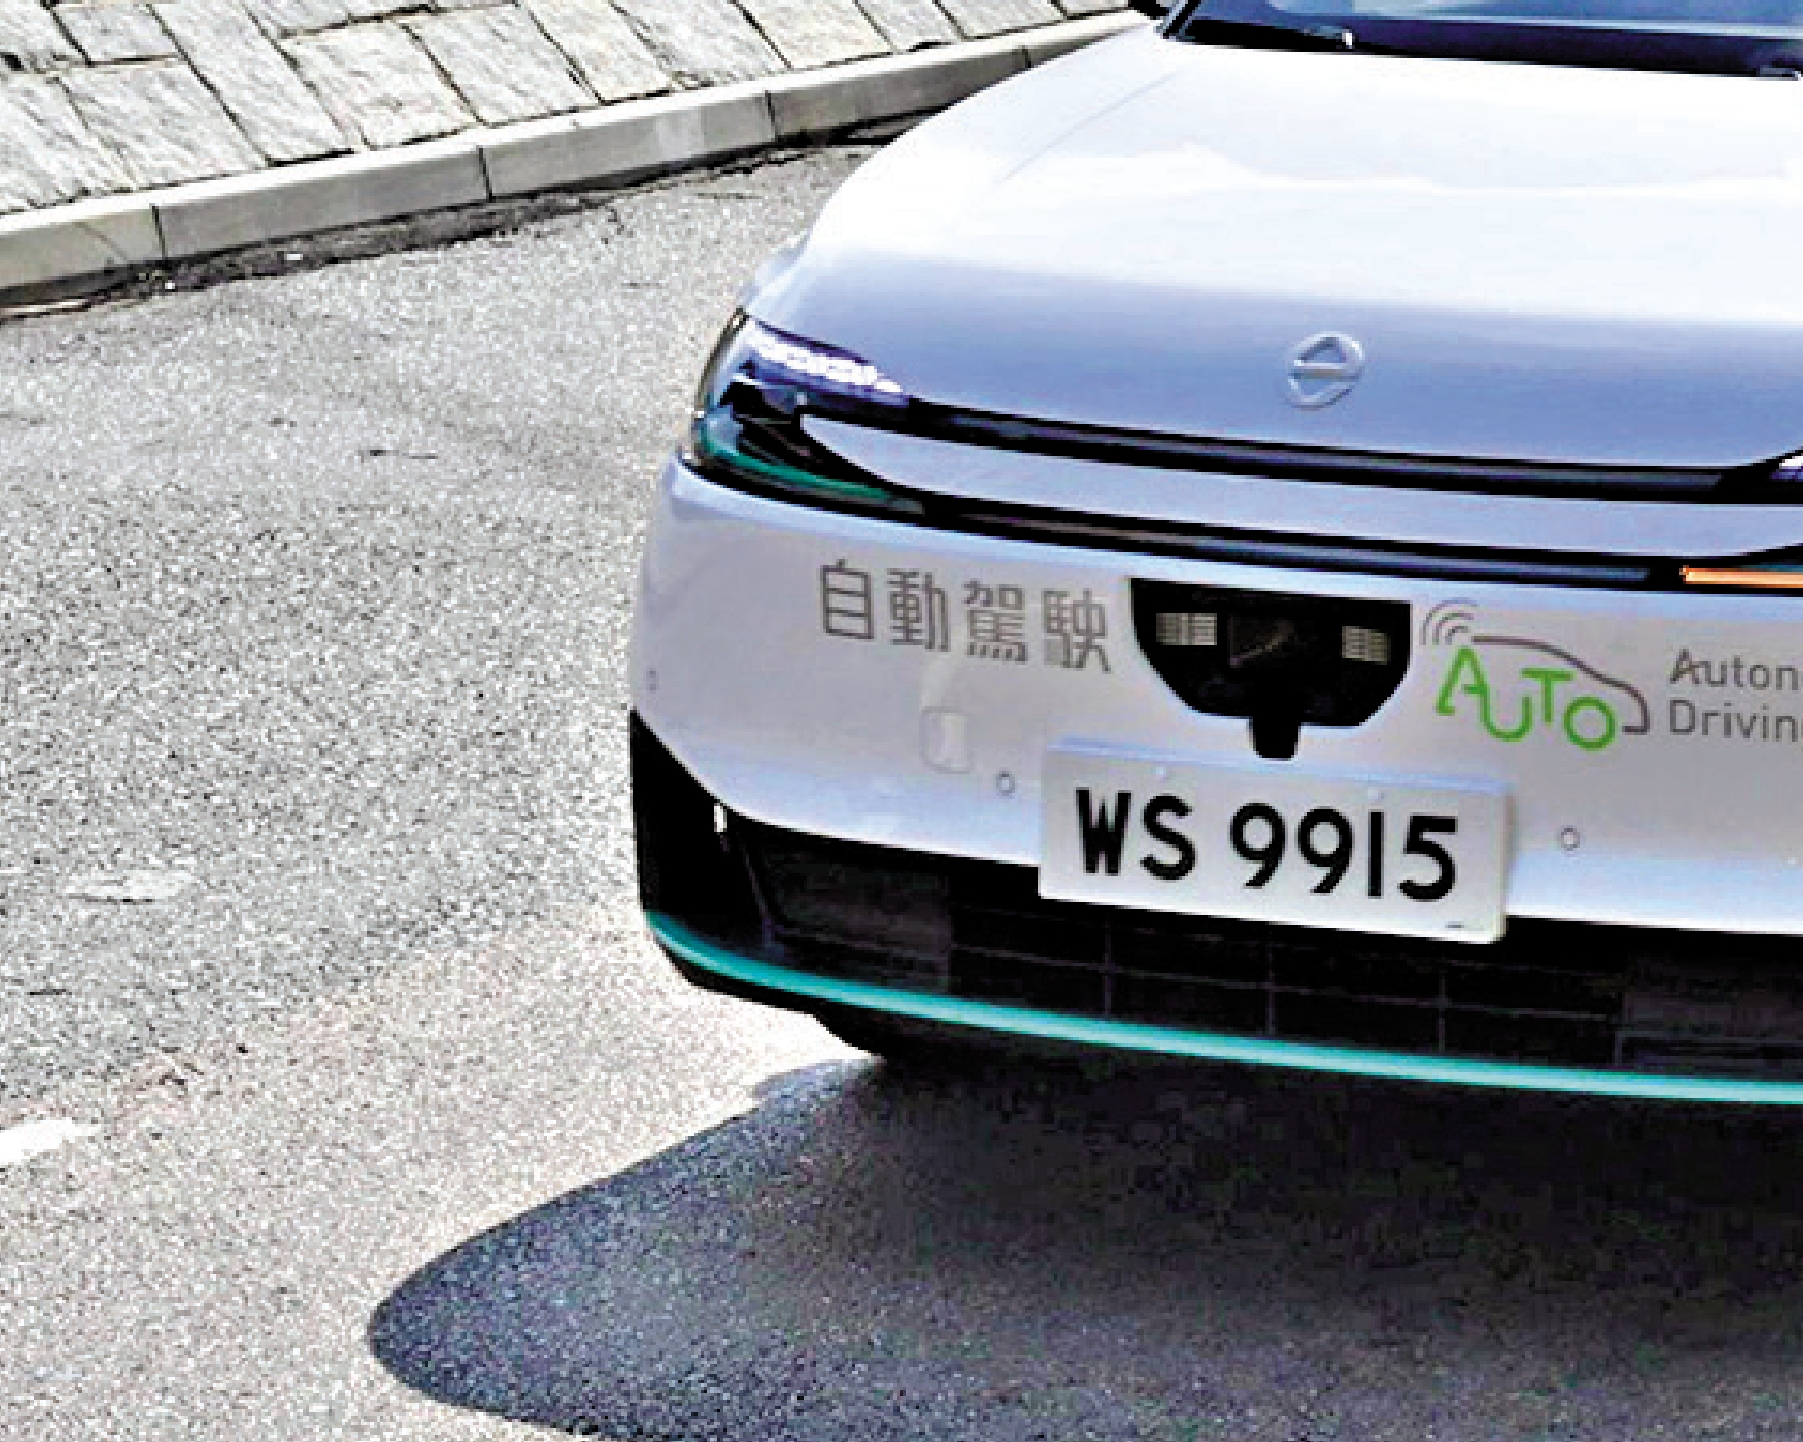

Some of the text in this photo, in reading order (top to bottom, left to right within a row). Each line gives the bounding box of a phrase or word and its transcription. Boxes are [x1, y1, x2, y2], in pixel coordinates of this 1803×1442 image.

[820, 558, 1112, 673] 自動駕駛
[1075, 787, 1460, 903] WS 9915
